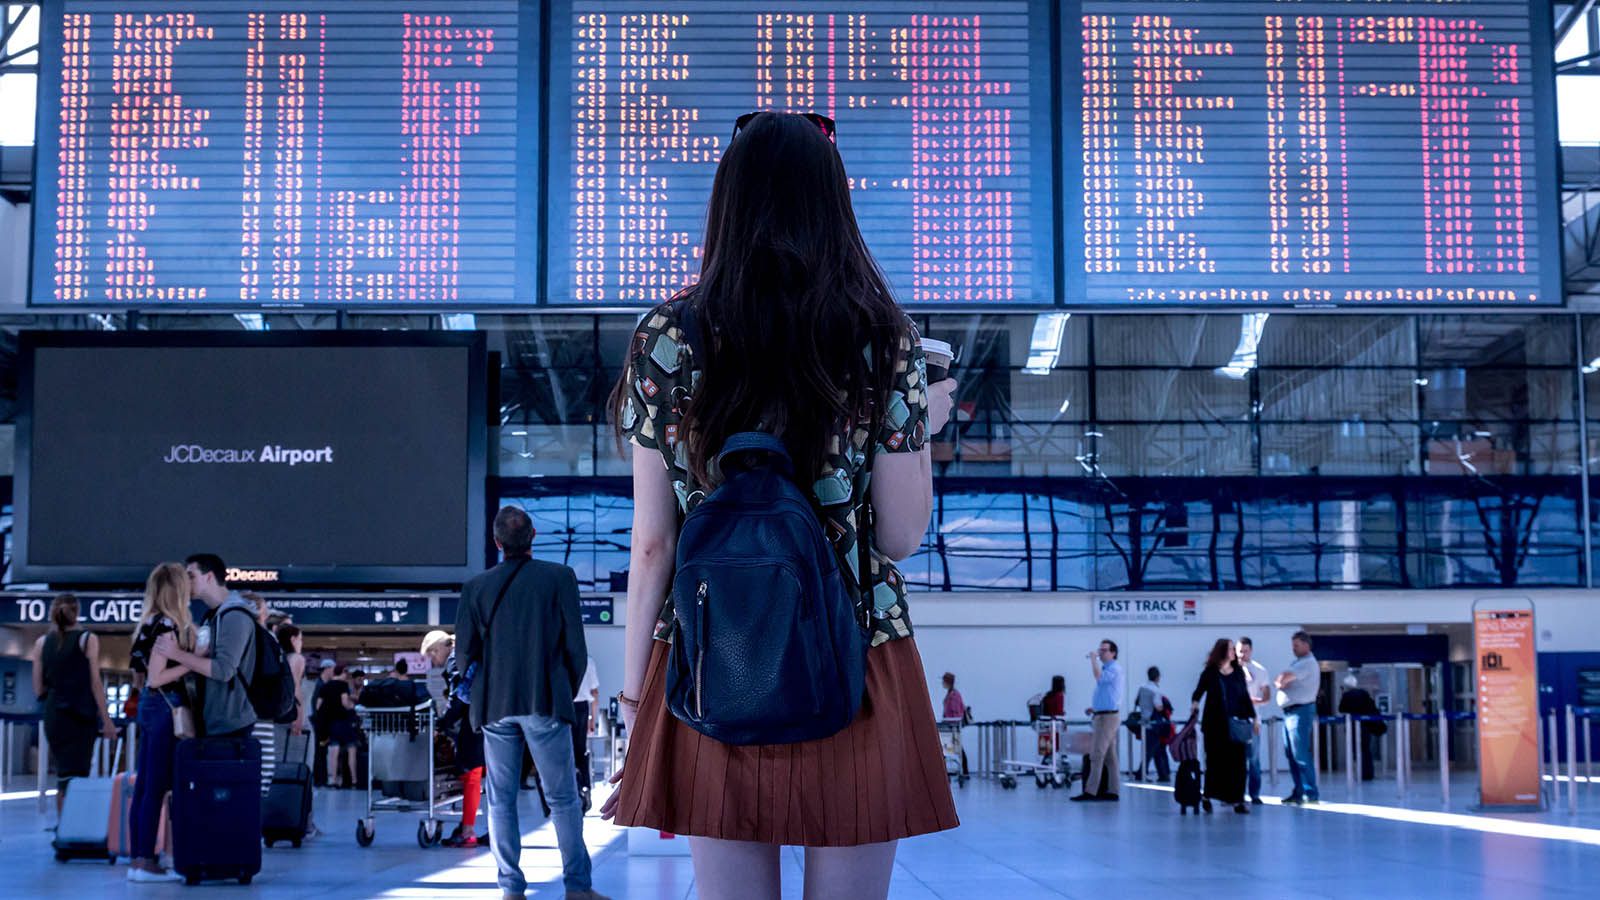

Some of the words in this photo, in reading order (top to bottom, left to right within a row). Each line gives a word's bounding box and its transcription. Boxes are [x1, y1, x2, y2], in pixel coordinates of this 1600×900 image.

[164, 445, 255, 463] JCDecaux
[259, 445, 333, 466] Airport
[16, 599, 46, 622] TO
[273, 600, 290, 609] YOUR
[291, 600, 323, 609] PASSPORT
[323, 600, 337, 609] AND
[338, 600, 370, 609] BOARDING
[370, 600, 386, 609] PASS
[387, 600, 408, 609] READY
[1099, 600, 1130, 611] FAST
[1135, 600, 1176, 611] TRACK
